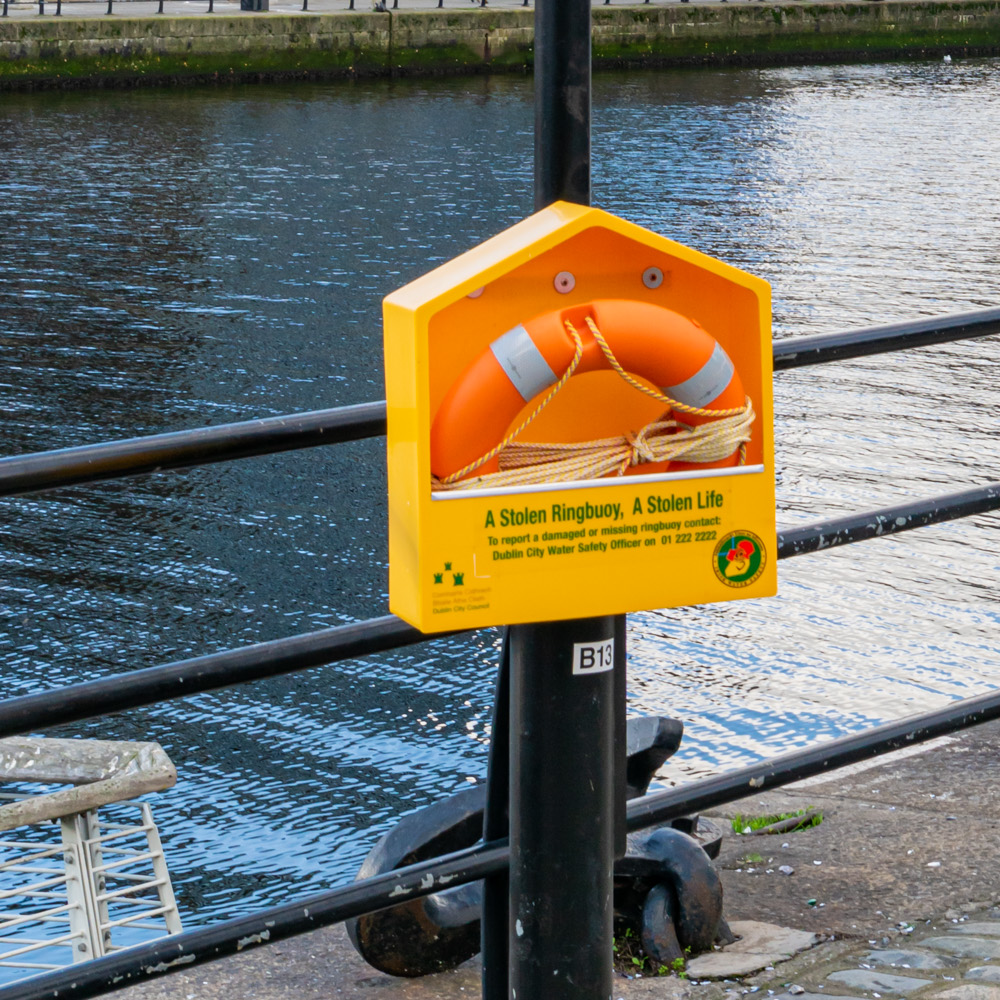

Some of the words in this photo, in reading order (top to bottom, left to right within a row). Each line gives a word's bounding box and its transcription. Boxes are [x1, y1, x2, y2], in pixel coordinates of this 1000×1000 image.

[485, 510, 495, 528] A
[500, 507, 547, 527] Stolen
[552, 501, 624, 524] Ringbuoy,
[633, 497, 643, 515] A
[647, 494, 692, 514] Stolen
[697, 490, 723, 509] Life
[488, 536, 498, 546] To
[501, 533, 530, 546] report
[533, 534, 539, 542] a
[542, 528, 586, 541] damaged
[588, 528, 598, 537] or
[601, 524, 638, 535] missing
[641, 521, 681, 533] ringbuoy
[684, 516, 721, 528] contact:
[493, 549, 523, 561] Dublin
[526, 547, 544, 558] City
[547, 545, 575, 555] Water
[578, 541, 607, 553] Safety
[610, 539, 641, 550] Officer
[644, 538, 656, 547] on
[661, 535, 672, 545] 01
[675, 533, 692, 544] 222
[695, 530, 717, 542] 2222
[580, 644, 612, 669] B13
